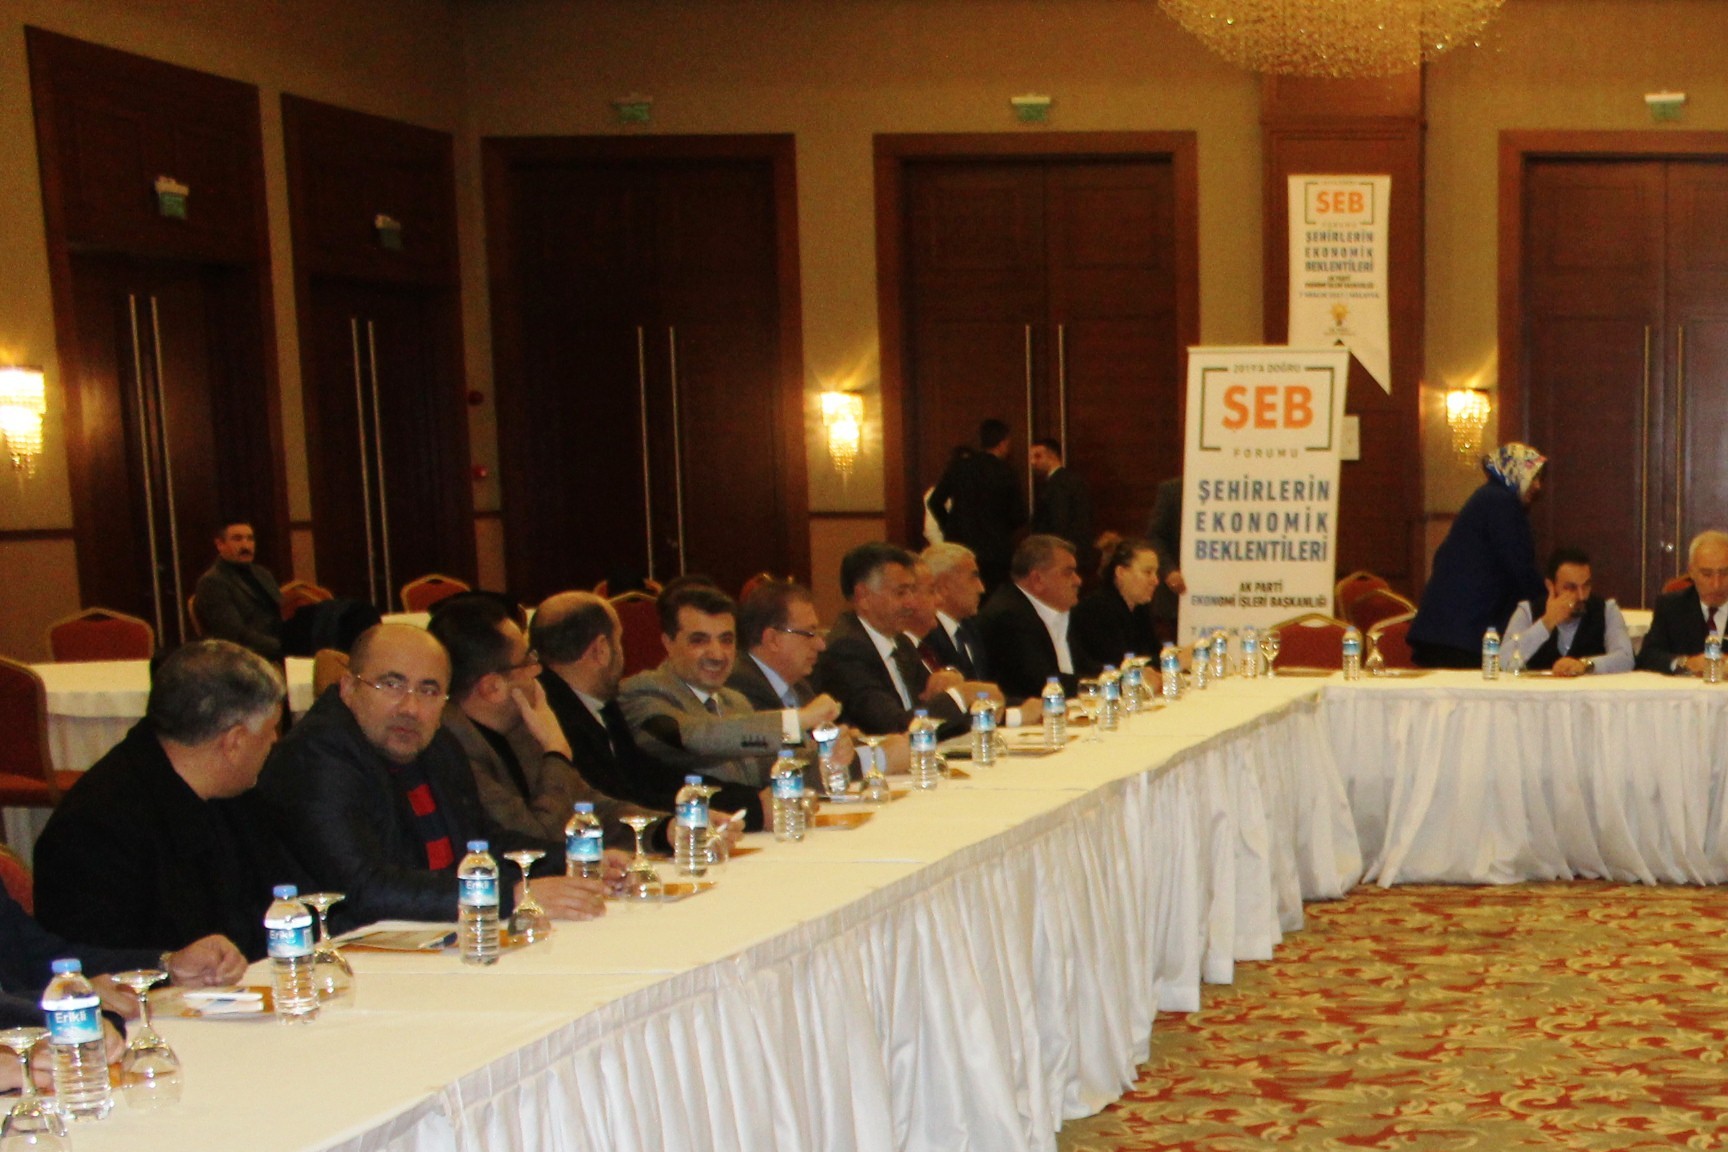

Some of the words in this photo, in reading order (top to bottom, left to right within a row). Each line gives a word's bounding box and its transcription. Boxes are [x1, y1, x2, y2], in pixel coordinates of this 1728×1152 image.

[1233, 449, 1298, 458] FORUMU
[1199, 474, 1330, 504] ŞEHİRLERİN
[1195, 507, 1328, 533] EKONOMİK
[1194, 535, 1328, 562] BEKLENTİLERİ
[55, 1010, 86, 1024] Erikli
